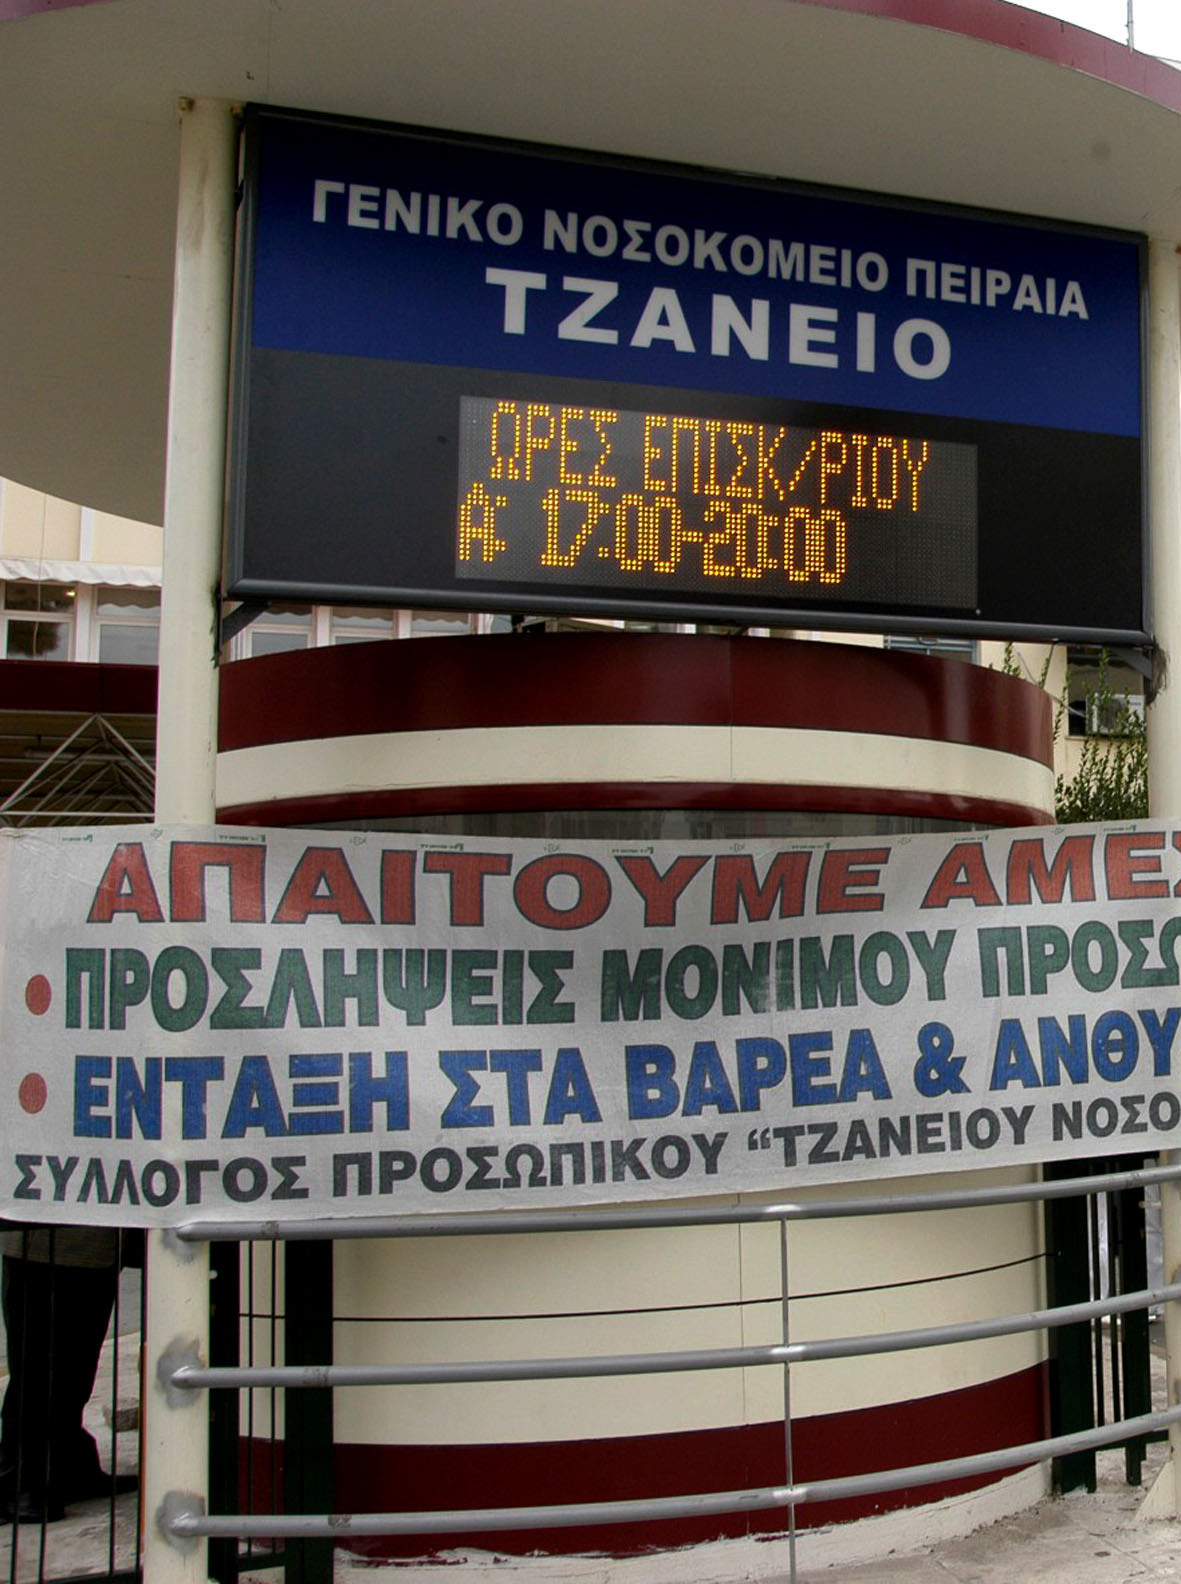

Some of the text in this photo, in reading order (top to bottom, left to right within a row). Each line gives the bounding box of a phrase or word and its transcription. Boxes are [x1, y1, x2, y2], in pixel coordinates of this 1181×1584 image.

[312, 179, 1090, 320] ΓΕΝΙΚΟ ΝΟΣΟΚΟΜΕΙΟ ΠΕΙΡΑΙΑ
[485, 267, 953, 381] ΤΖΑΝΕΙΟ
[490, 401, 928, 512] ΩΡΕΣ ΕΠΙΣΚ/ΡΙΟΥ
[541, 488, 846, 584] 17:00-20:00
[86, 841, 892, 930] ΑΠΑΙΤΟΥΜΕ
[65, 945, 576, 1033] ΠΡΟΣΛΗΨΕΙΣ
[601, 928, 957, 1022] ΜΟΝΙΜΟΥ
[73, 1050, 411, 1141] ΕΝΤΑΞΗ
[439, 1047, 603, 1130] ΣΤΑ
[625, 1028, 893, 1120] ΒΑΡΕΑ
[914, 1021, 972, 1099] &
[13, 1154, 310, 1208] ΣΥΛΛΟΓΟΣ
[333, 1132, 729, 1198] ΠΡΟΣΩΠΙΚΟΥ
